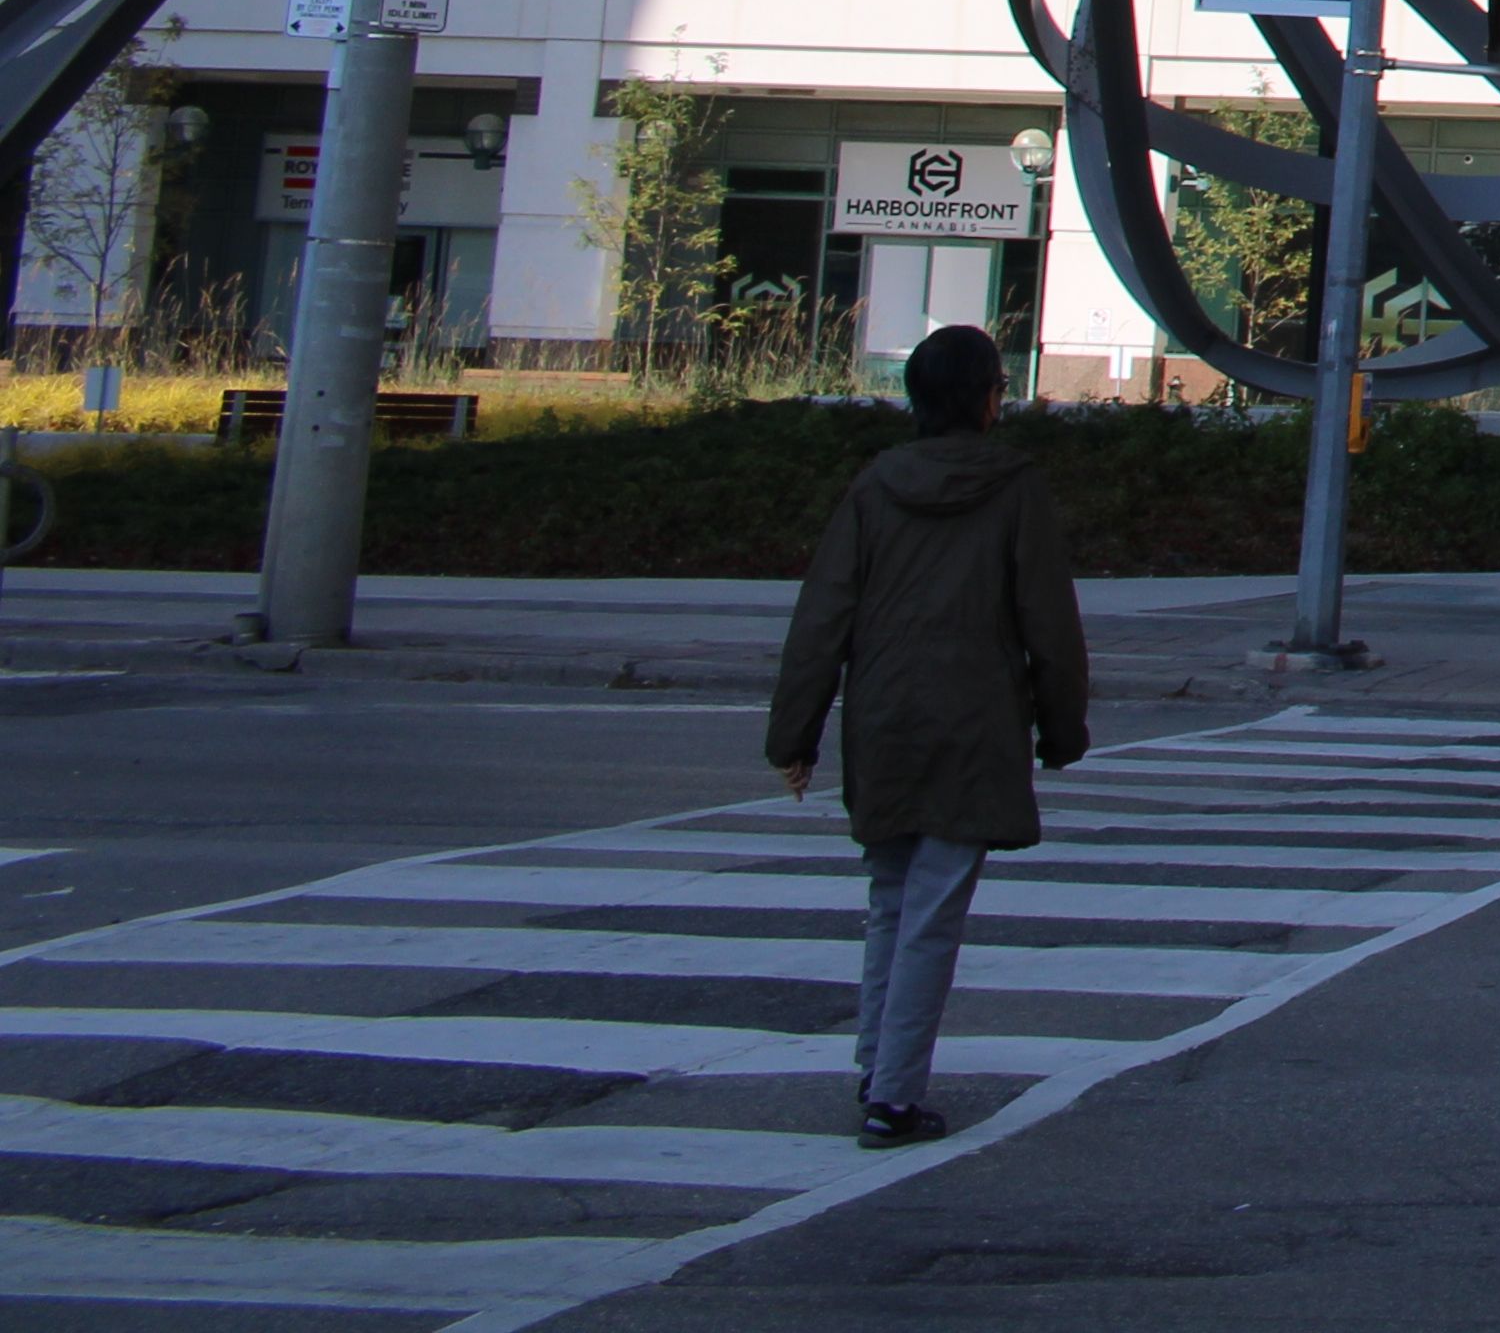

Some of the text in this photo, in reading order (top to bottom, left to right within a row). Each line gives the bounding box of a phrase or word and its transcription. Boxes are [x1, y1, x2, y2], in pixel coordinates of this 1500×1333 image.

[387, 9, 437, 20] IDLE LIMIT
[846, 199, 1019, 220] HARBOURFRONT
[884, 220, 978, 233] CANNABIS
